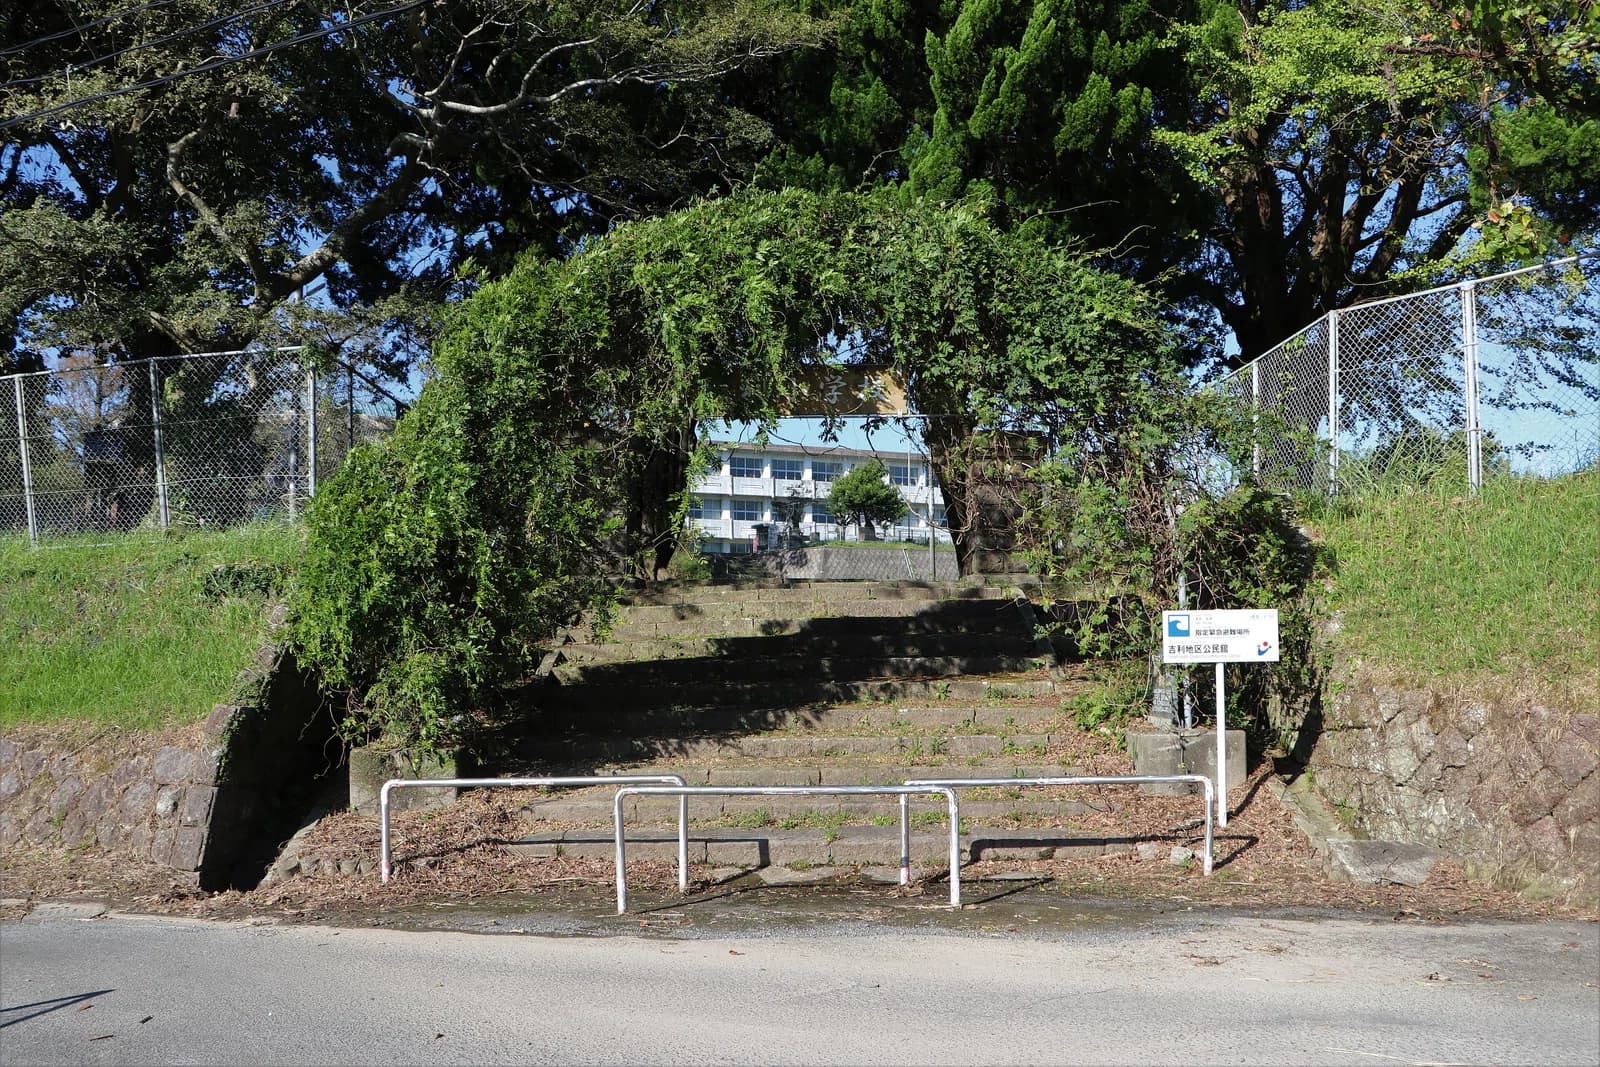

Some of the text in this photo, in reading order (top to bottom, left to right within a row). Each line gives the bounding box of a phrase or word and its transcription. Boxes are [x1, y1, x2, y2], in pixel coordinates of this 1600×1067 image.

[1195, 628, 1250, 636] 指定緊急避難場所
[1168, 644, 1229, 654] 吉利地区公民館
